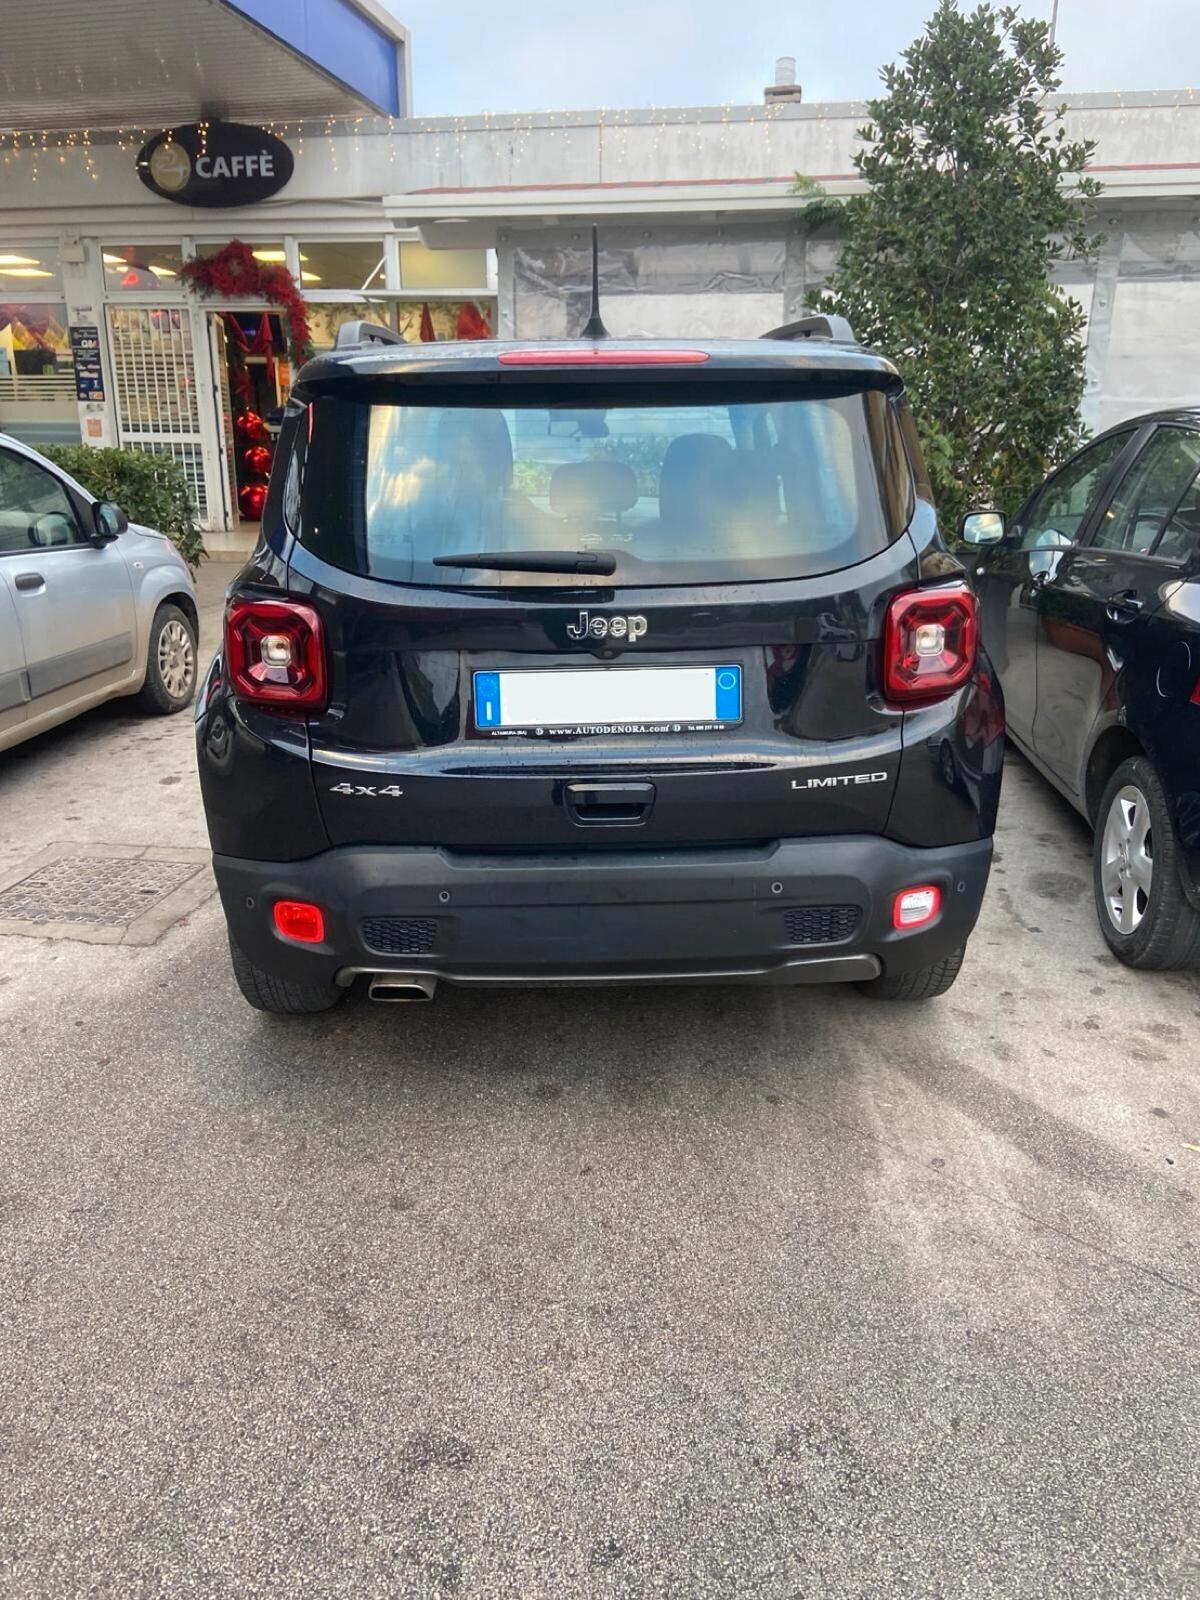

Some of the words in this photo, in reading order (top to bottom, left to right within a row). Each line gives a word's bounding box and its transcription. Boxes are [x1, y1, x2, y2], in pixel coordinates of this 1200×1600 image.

[195, 149, 275, 179] CAFFÈ
[566, 611, 648, 642] Jeep
[549, 724, 668, 735] www.AUTODENORA.com
[329, 782, 404, 797] 4x4
[790, 771, 888, 790] LIMITED
